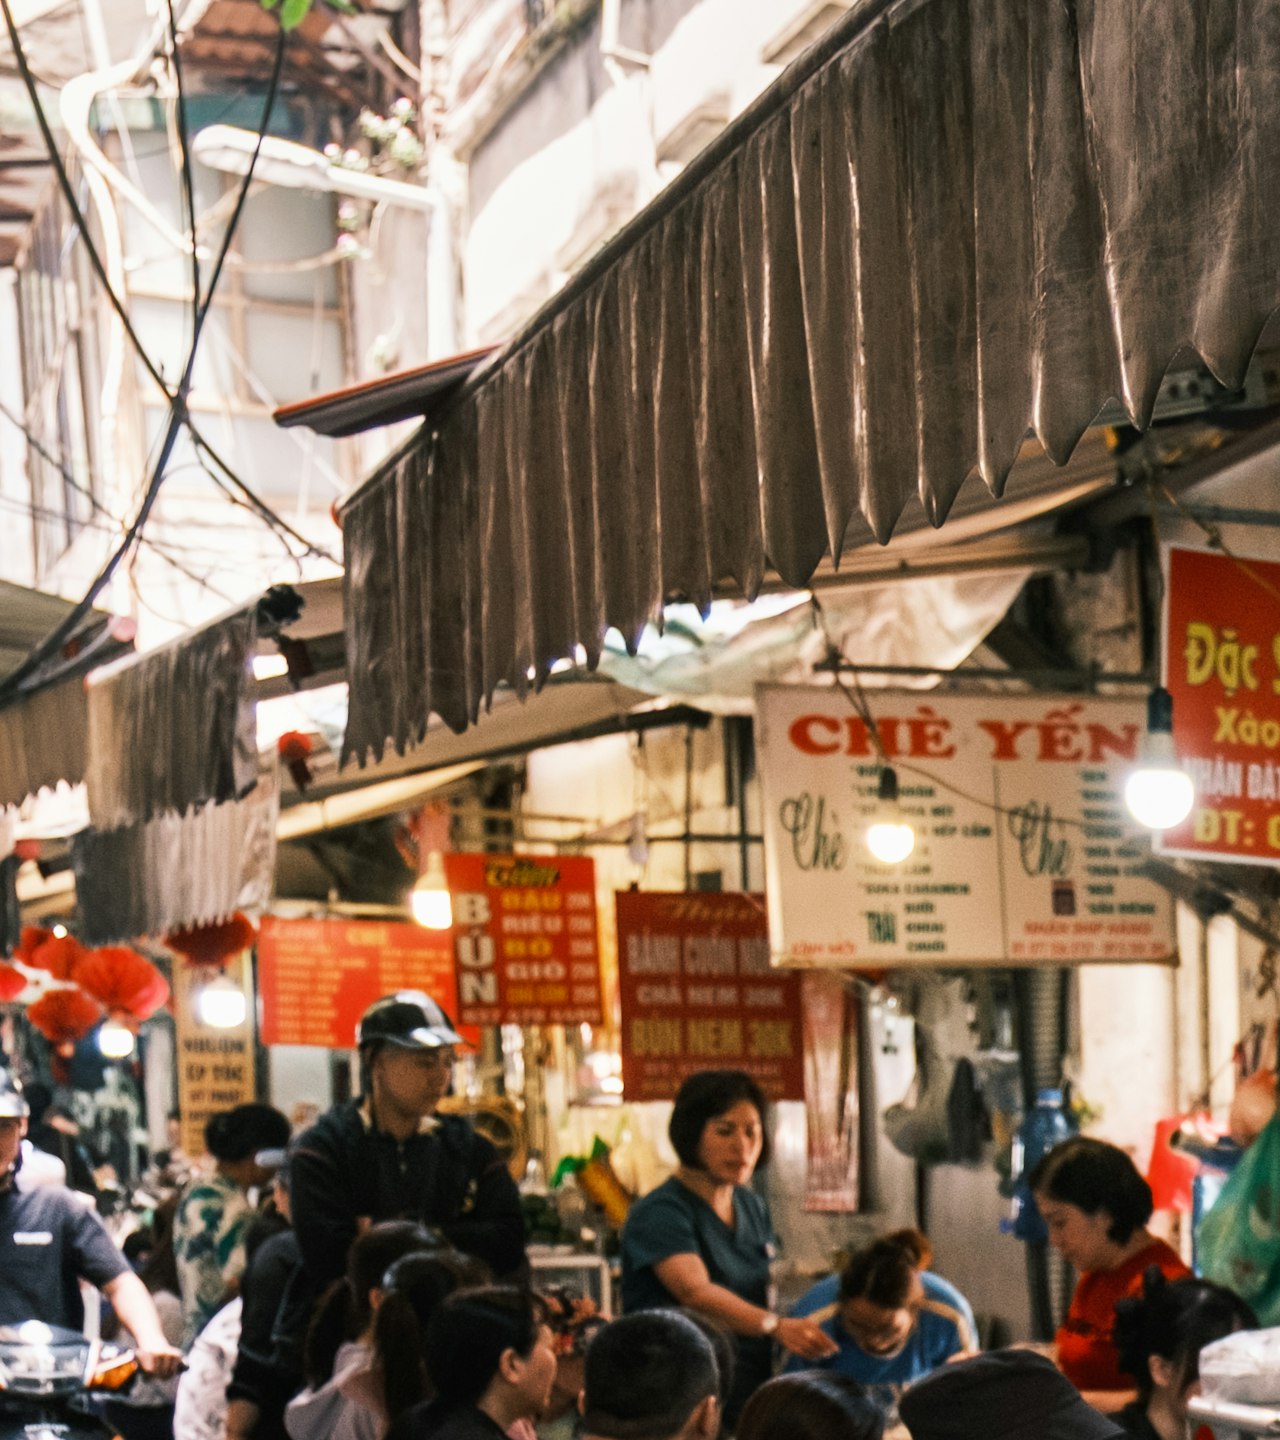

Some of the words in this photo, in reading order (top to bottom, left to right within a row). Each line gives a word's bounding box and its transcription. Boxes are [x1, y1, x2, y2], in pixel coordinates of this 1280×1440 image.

[1185, 622, 1259, 698] Đặc
[788, 704, 956, 759] CHÈ
[978, 703, 1141, 763] YẾN
[1214, 706, 1280, 749] Xào
[1193, 807, 1255, 846] ĐT:
[687, 1018, 743, 1057] NEM
